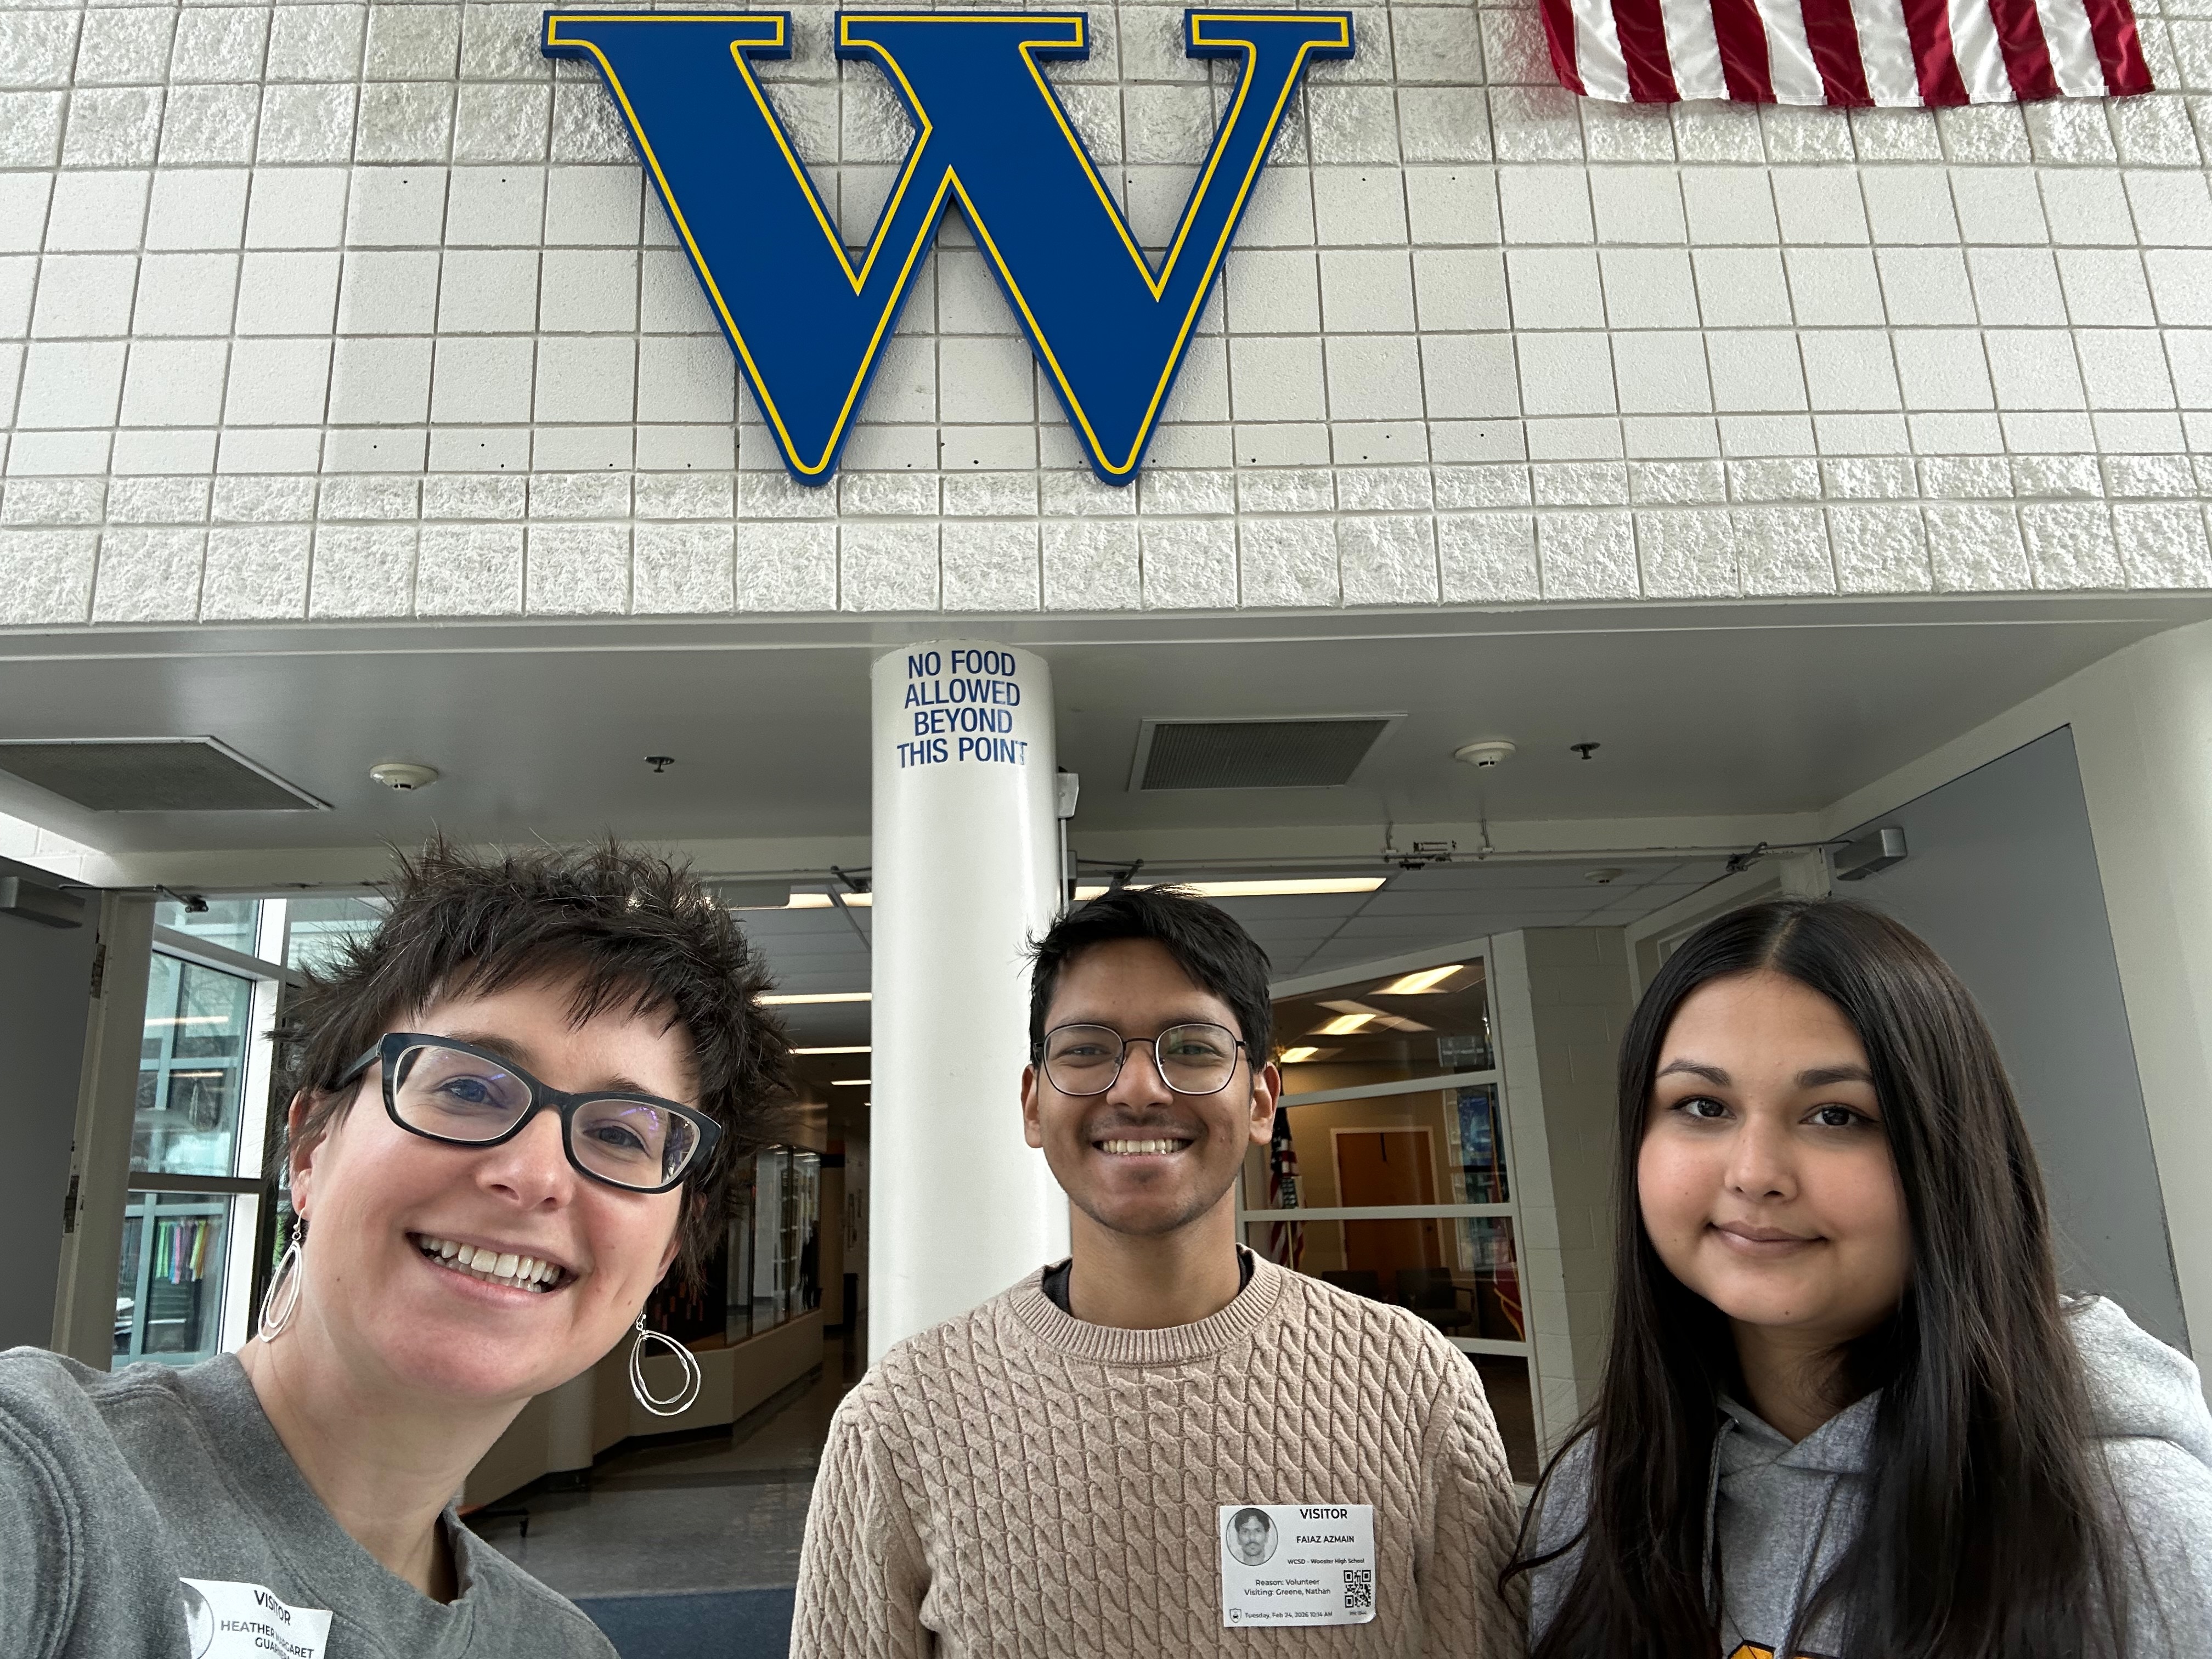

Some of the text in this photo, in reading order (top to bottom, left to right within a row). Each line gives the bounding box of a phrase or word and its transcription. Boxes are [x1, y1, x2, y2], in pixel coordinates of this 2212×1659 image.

[541, 9, 1355, 487] W
[909, 650, 1015, 679] NO FOOD
[905, 679, 1020, 709] ALLOWED
[914, 708, 1013, 736] BEYOND
[897, 737, 1028, 768] THIS POINT
[1299, 1508, 1347, 1519] VISITOR
[1244, 1589, 1273, 1597] Visiting:
[254, 1590, 290, 1626] VISITOR
[221, 1620, 274, 1638] HEATHER
